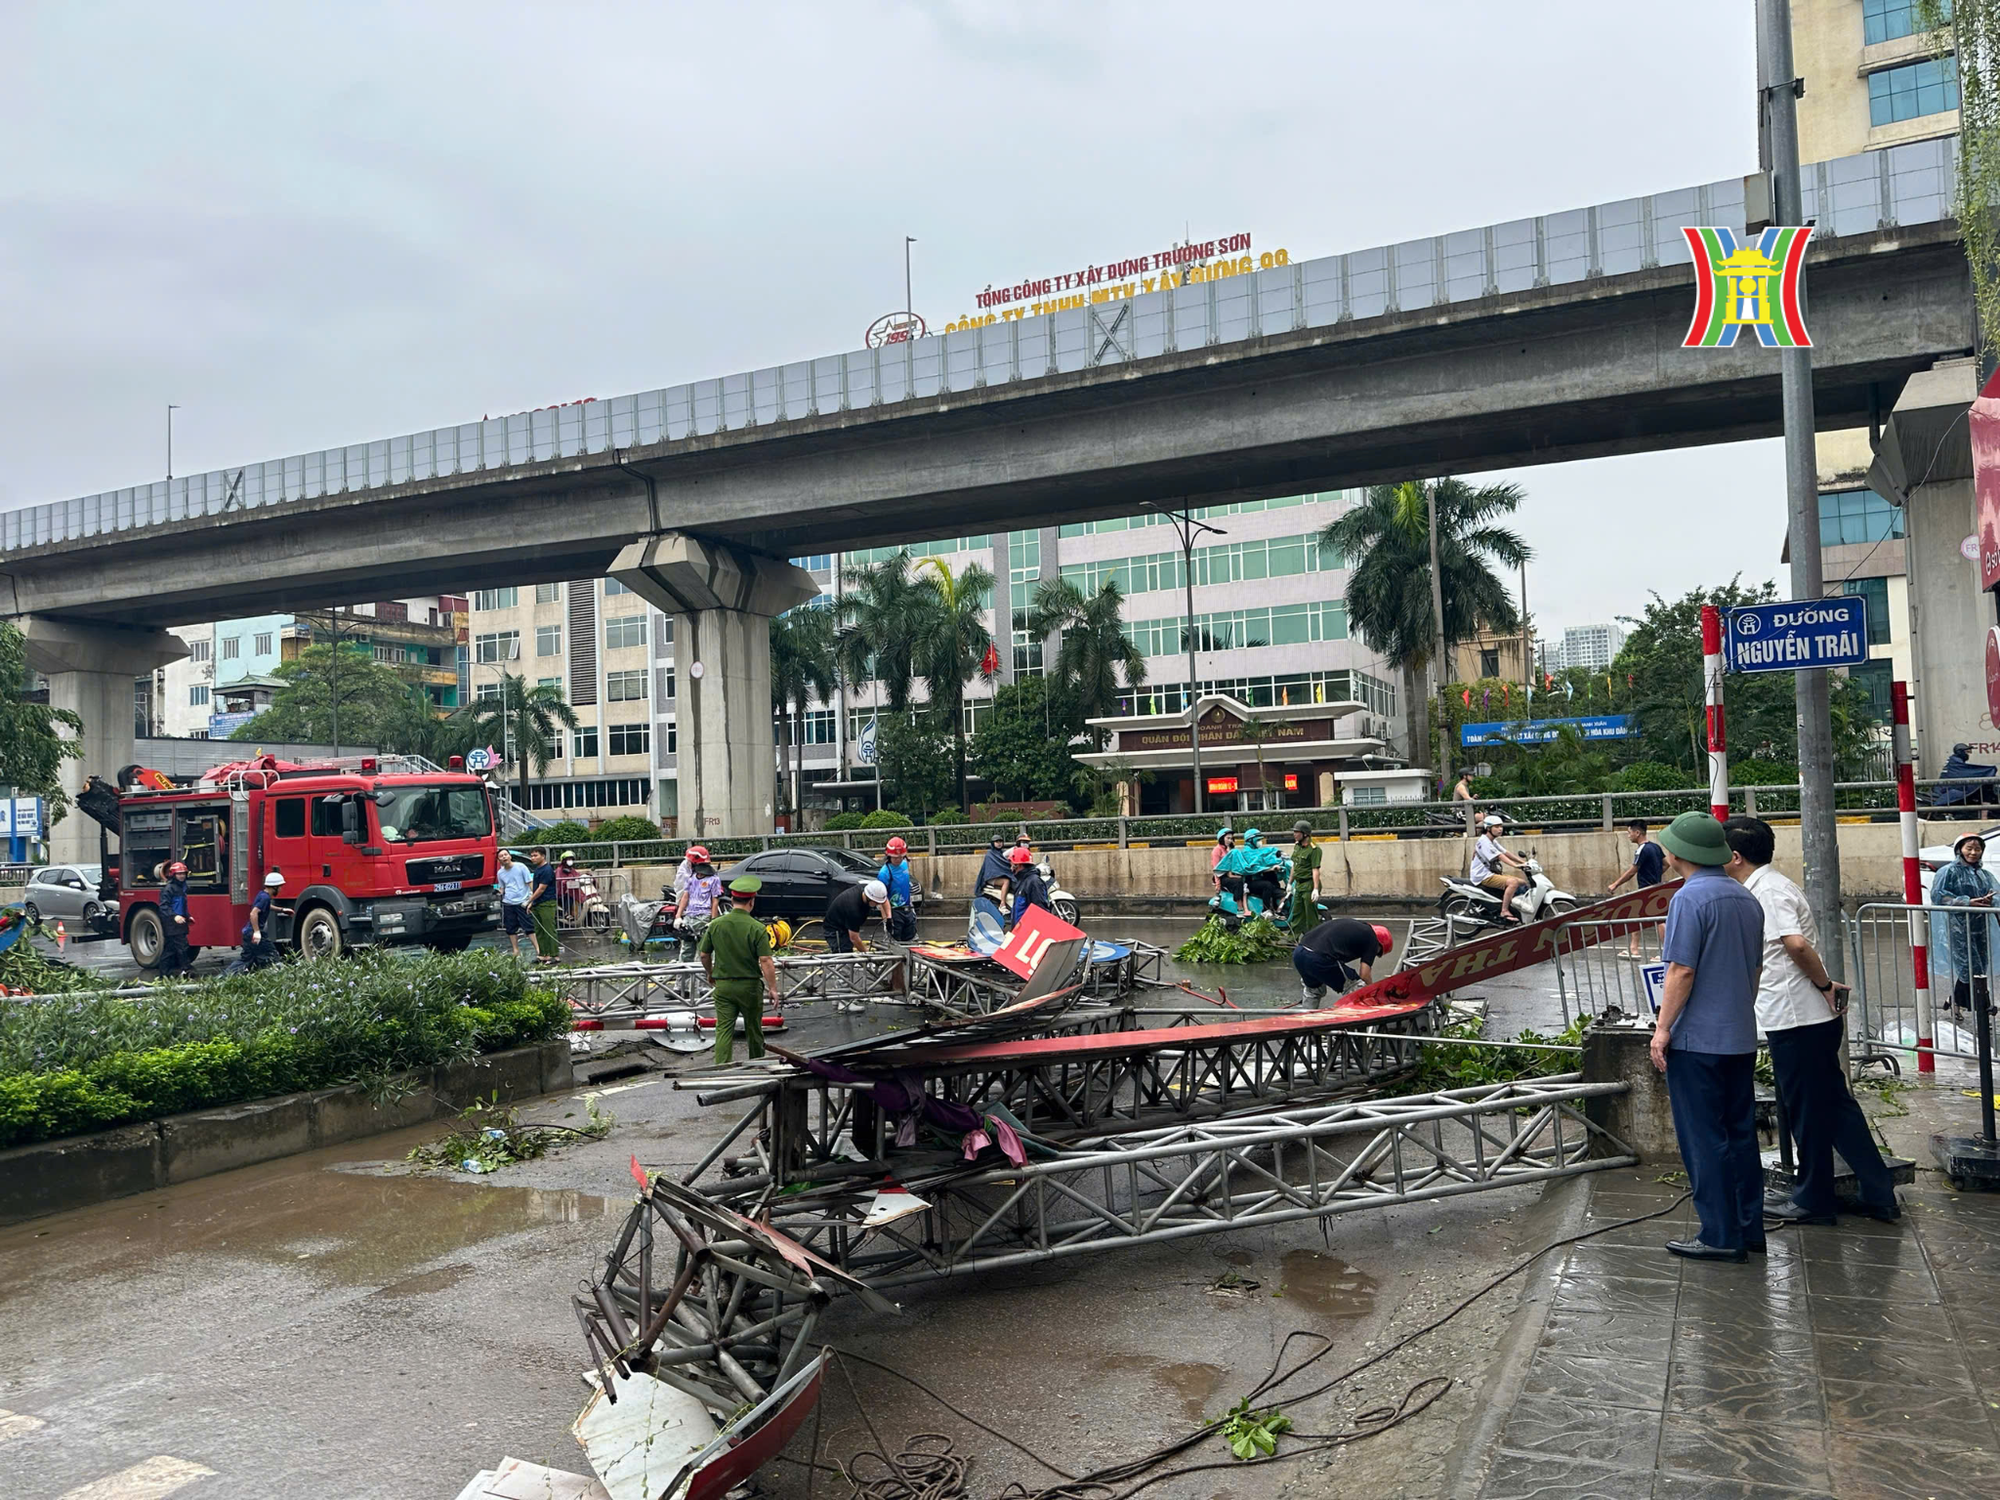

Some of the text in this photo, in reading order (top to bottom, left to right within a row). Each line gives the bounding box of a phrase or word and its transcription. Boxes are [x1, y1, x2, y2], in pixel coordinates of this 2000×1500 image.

[975, 232, 1251, 309] TỔNG CÔNG TY XÂY DỰNG TRƯỜNG SƠN
[1773, 607, 1849, 628] ĐƯỜNG
[1737, 630, 1859, 665] NGUYỄN TRÃI
[1142, 734, 1169, 745] QUÂN
[1172, 733, 1190, 744] ĐỘI
[1277, 727, 1304, 737] NAM
[704, 817, 720, 826] FR13
[434, 864, 461, 874] MAN
